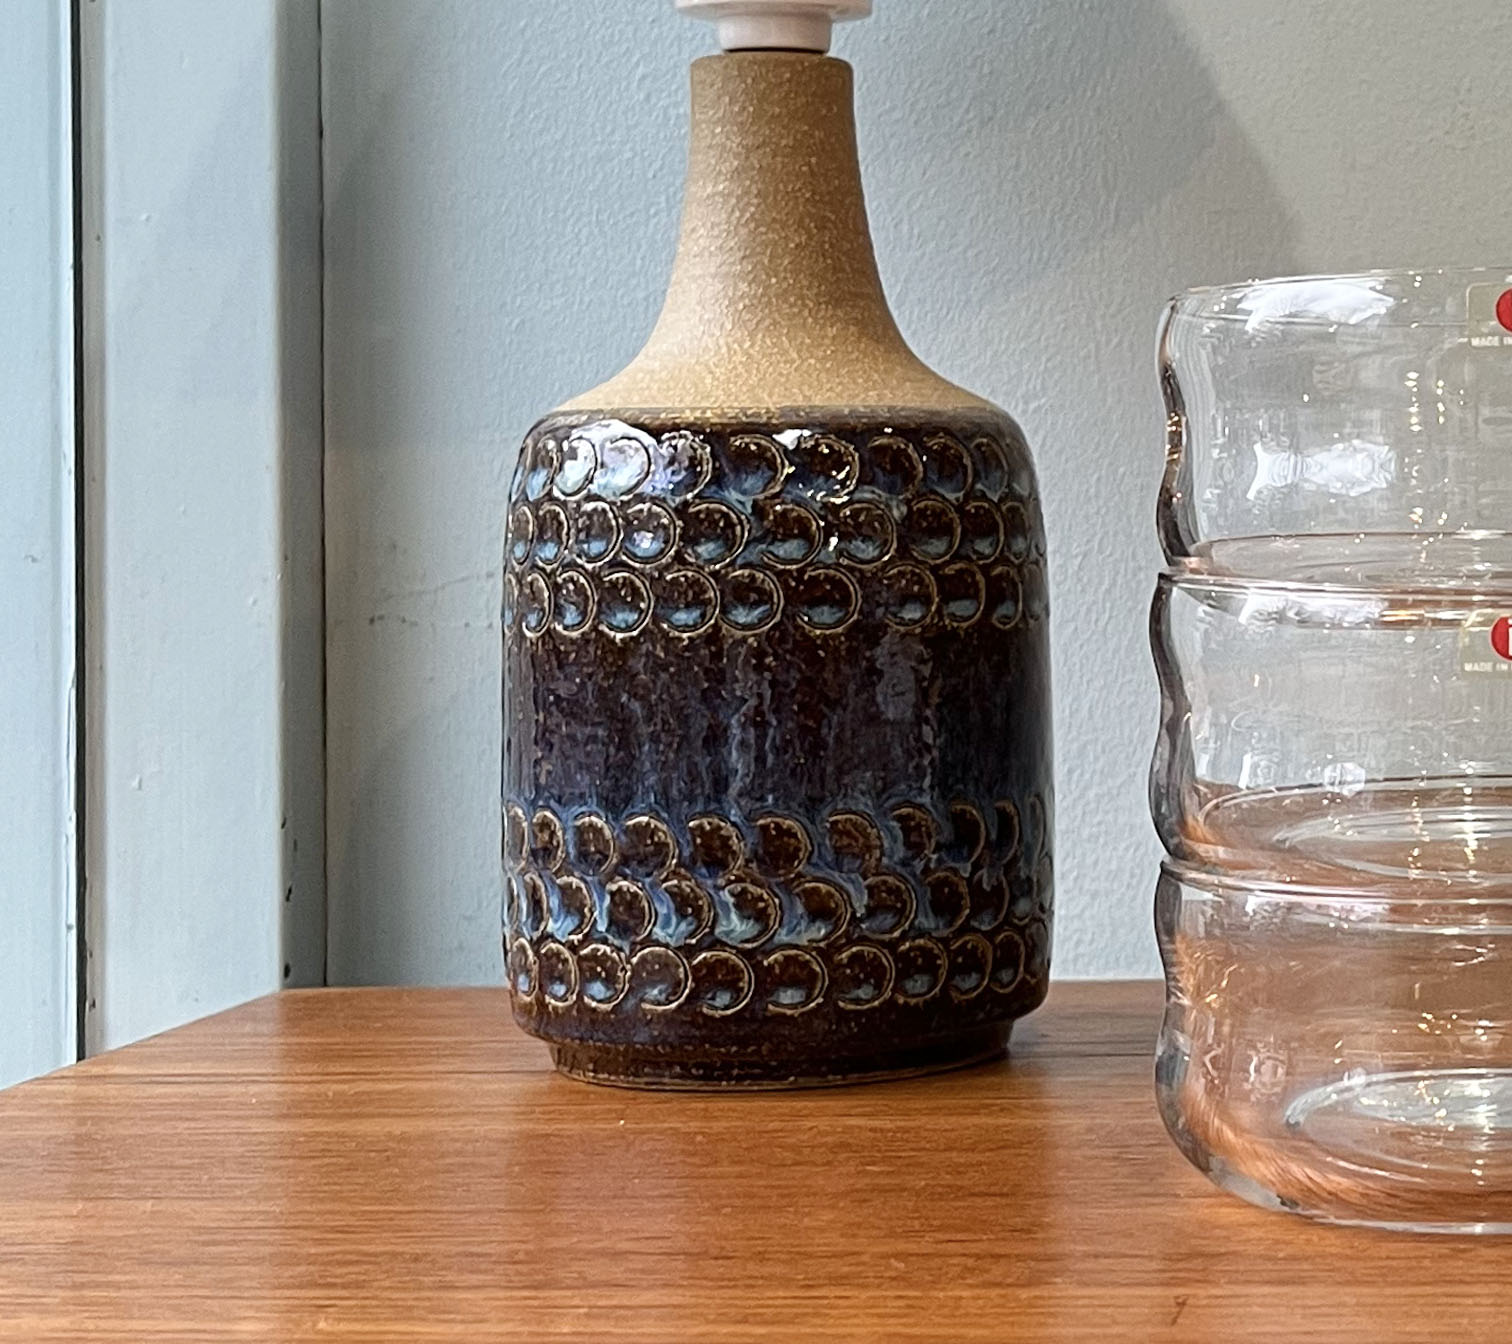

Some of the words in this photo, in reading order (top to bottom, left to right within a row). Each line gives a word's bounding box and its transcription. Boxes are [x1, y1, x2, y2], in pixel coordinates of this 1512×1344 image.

[1470, 336, 1500, 347] MADE
[1464, 661, 1493, 673] MADE
[1495, 661, 1508, 672] IN
